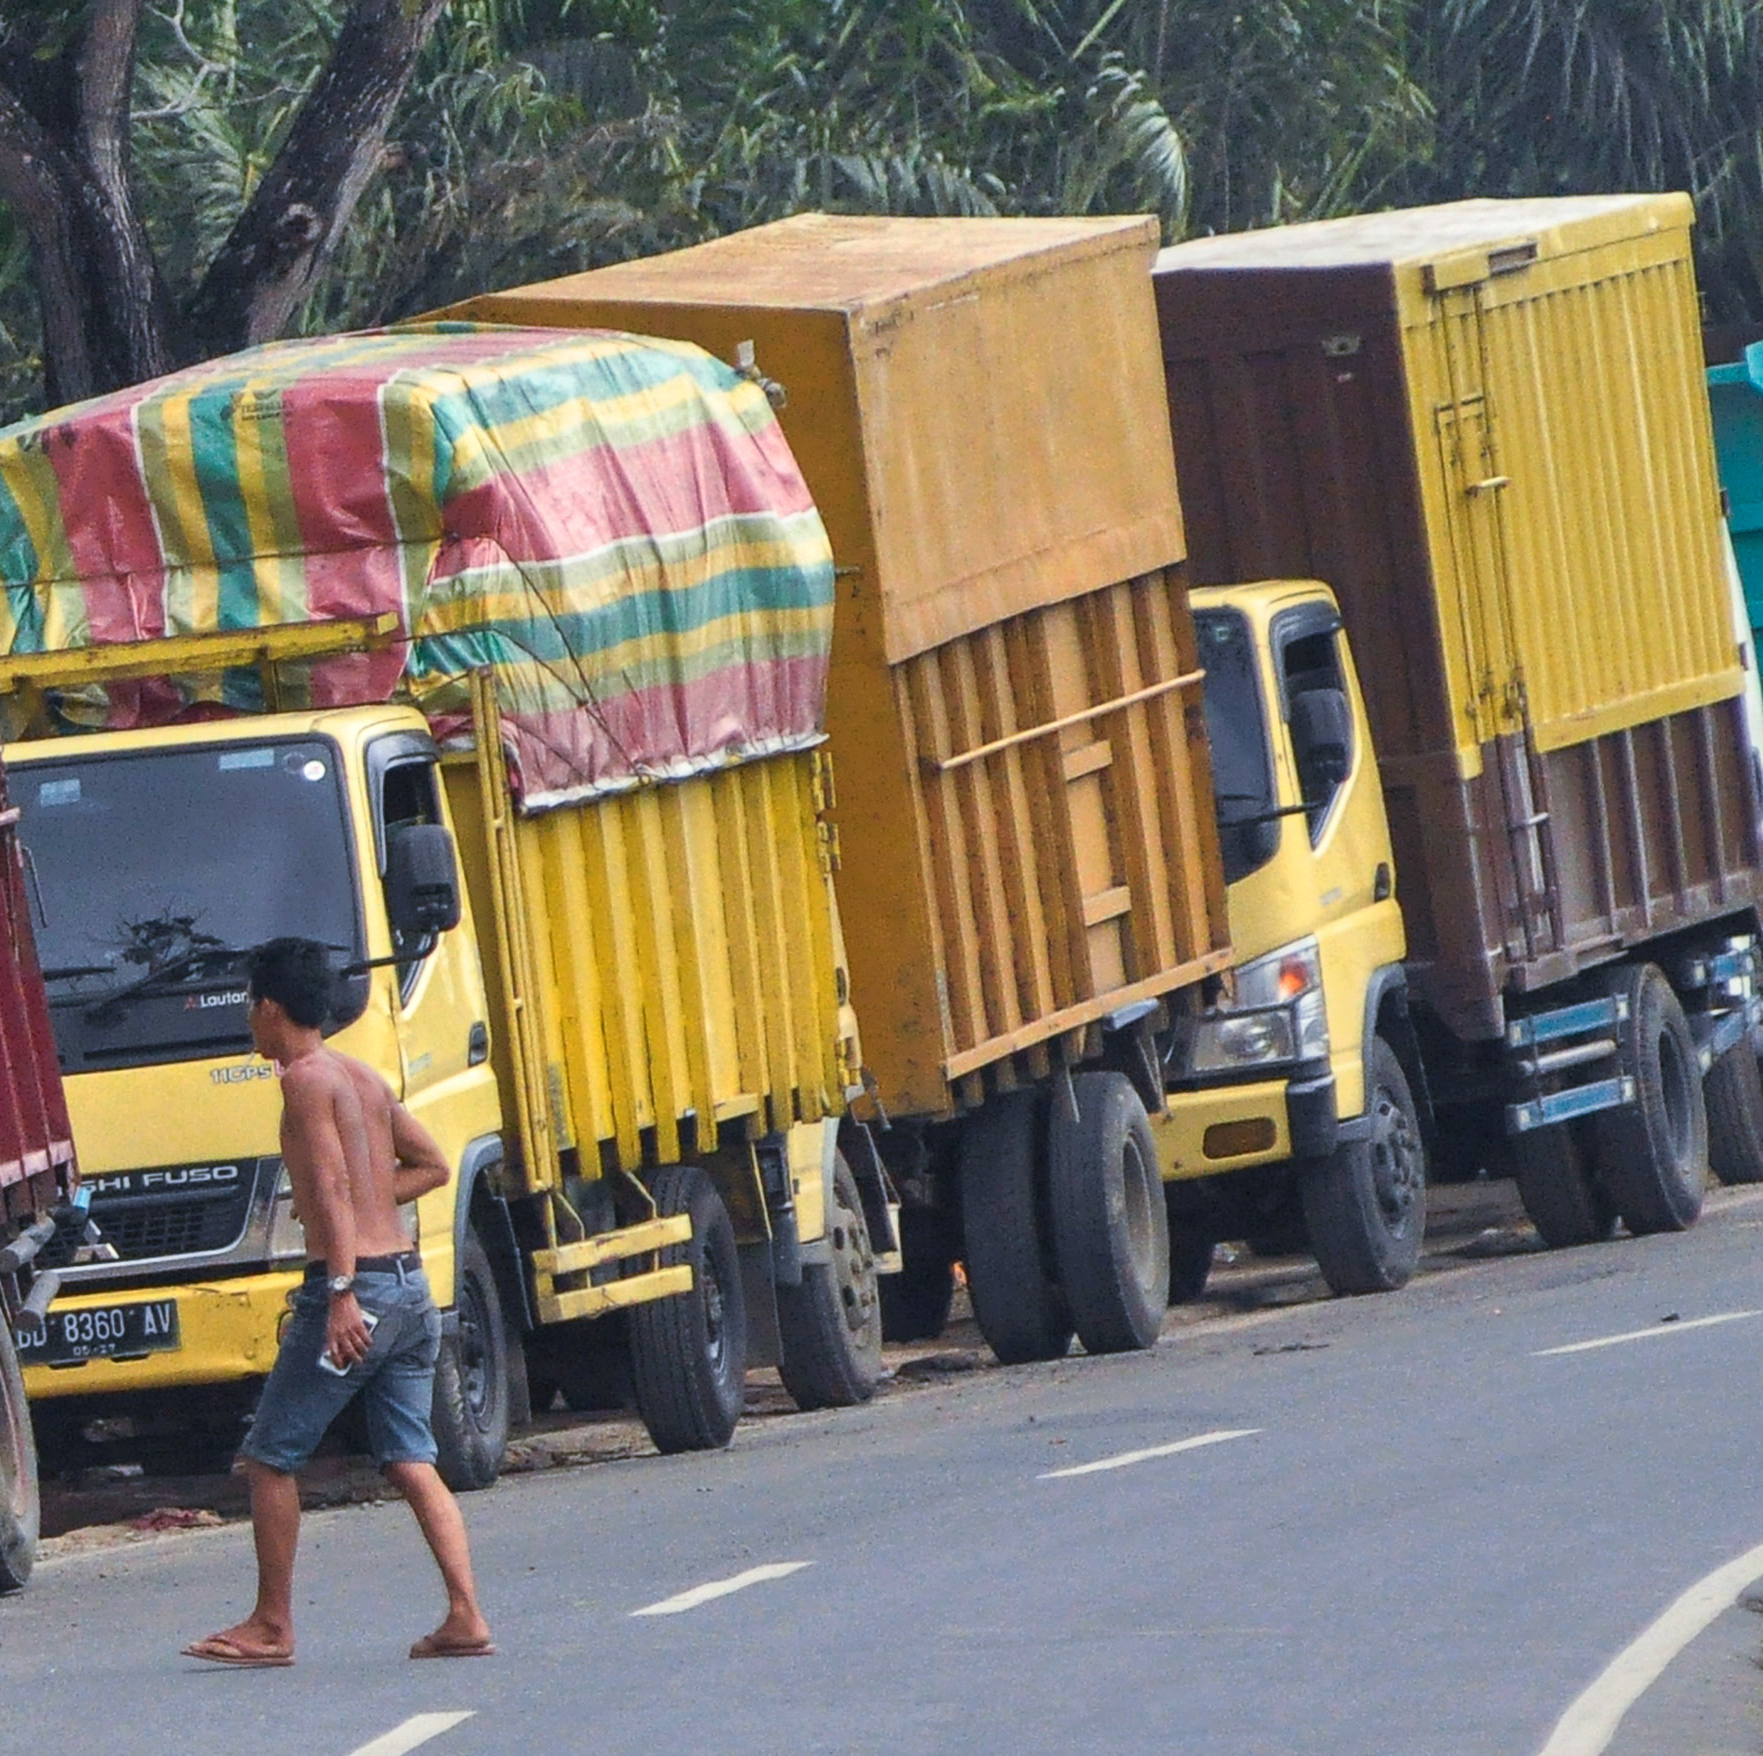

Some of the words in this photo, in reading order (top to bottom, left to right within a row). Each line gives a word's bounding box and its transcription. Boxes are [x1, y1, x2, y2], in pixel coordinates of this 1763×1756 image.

[142, 1164, 239, 1188] FUSO
[63, 1309, 125, 1343] 8360
[144, 1303, 171, 1336] AV
